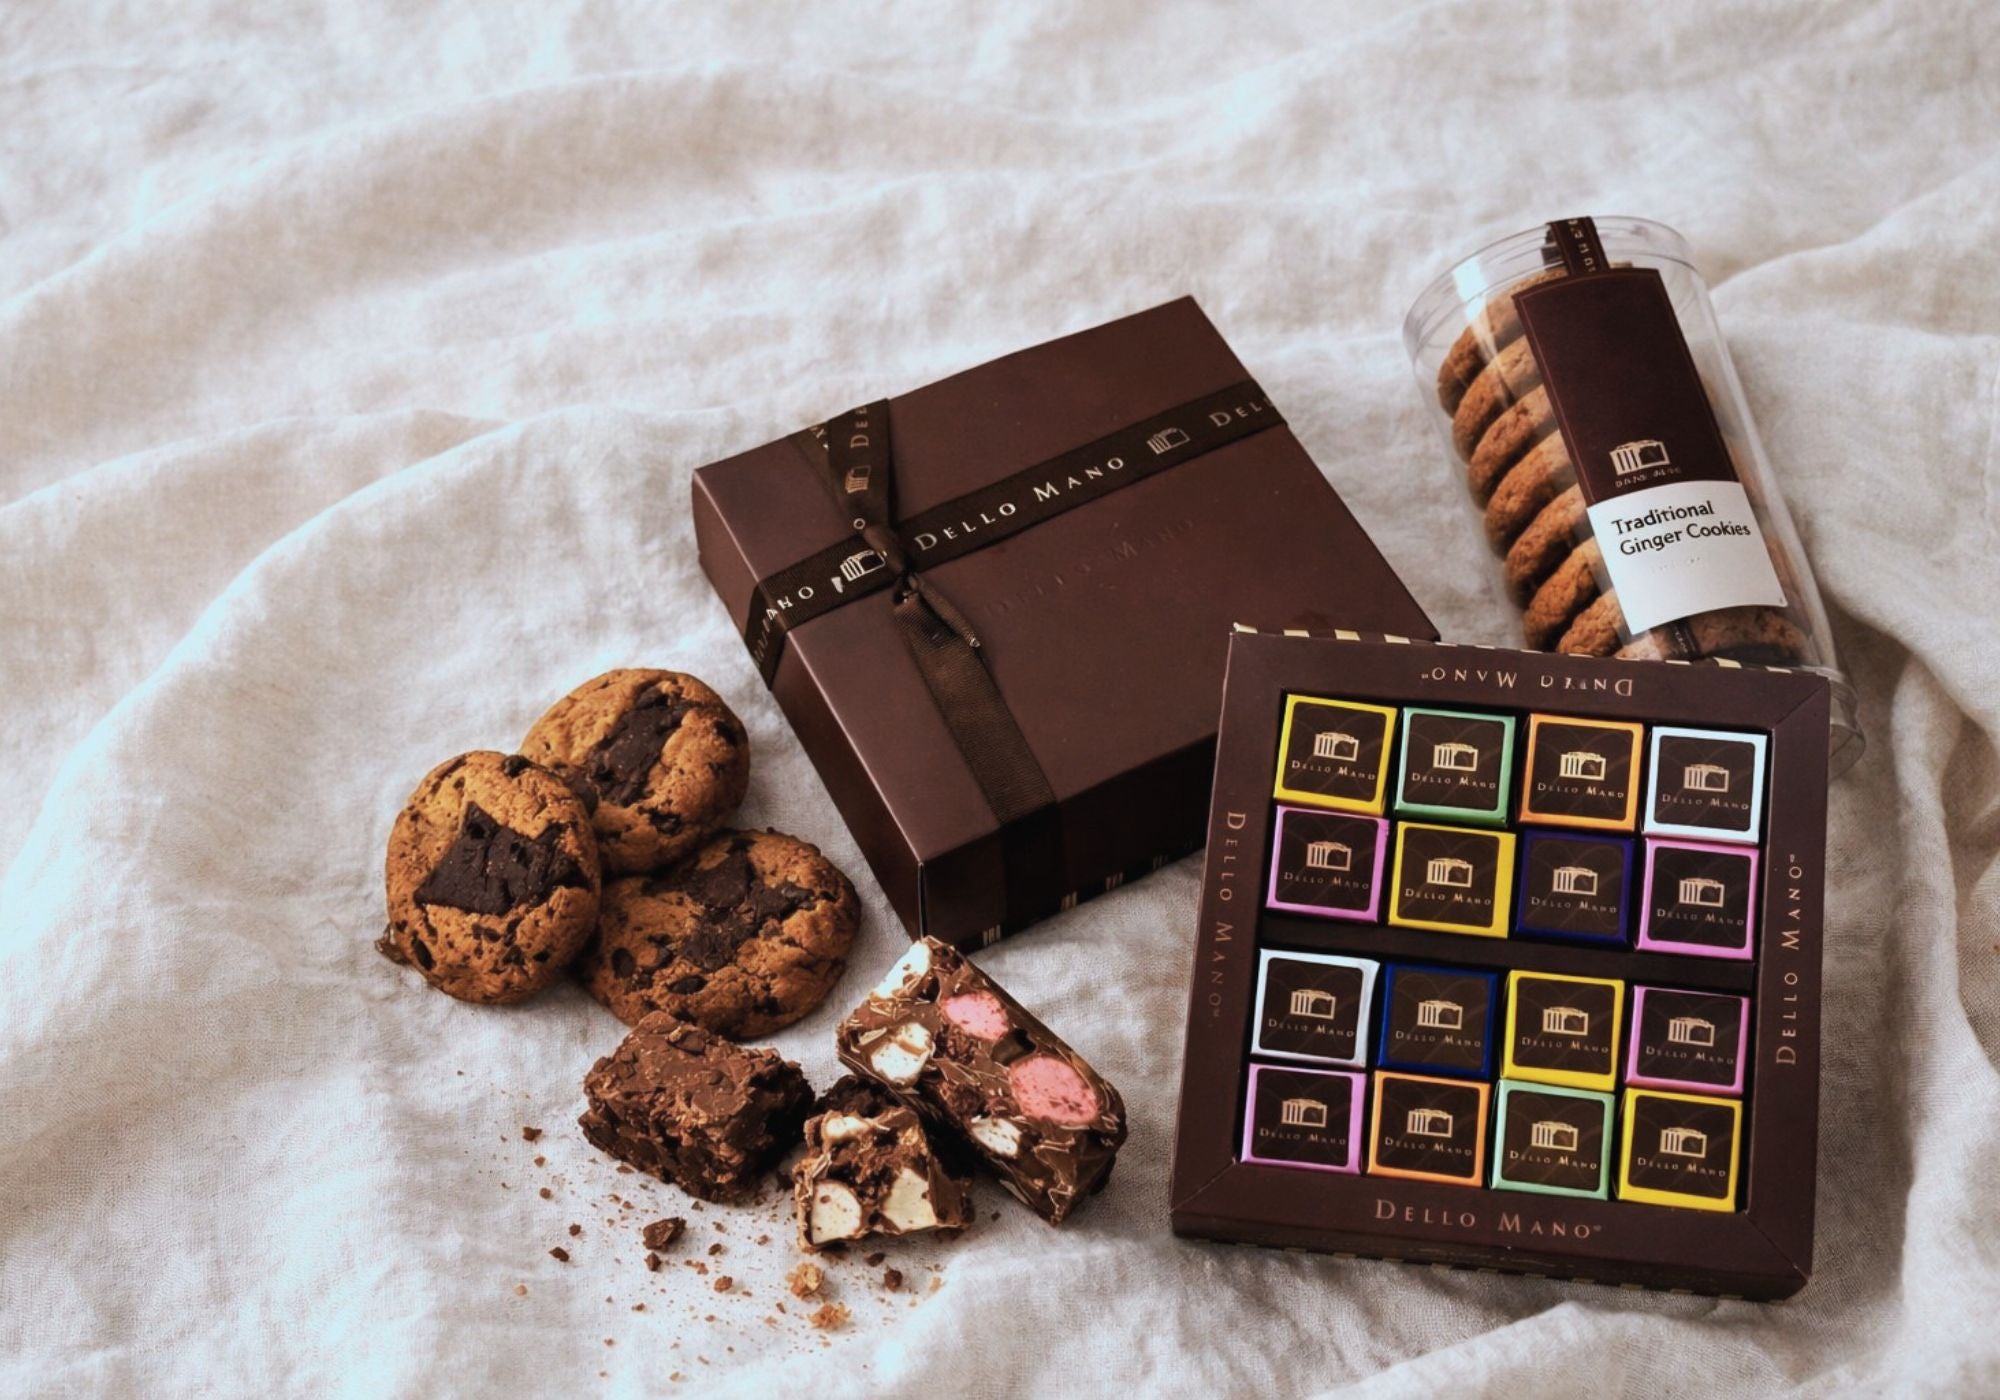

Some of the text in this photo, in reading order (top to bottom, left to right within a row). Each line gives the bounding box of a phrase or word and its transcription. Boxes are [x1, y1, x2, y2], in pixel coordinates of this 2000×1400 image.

[913, 456, 1125, 551] DELLO MANO
[1611, 499, 1716, 536] Traditional
[1619, 520, 1752, 556] Ginger Cookies
[1219, 811, 1247, 901] DELLO
[1775, 972, 1798, 1065] DELLO
[1375, 1198, 1477, 1228] DELLO
